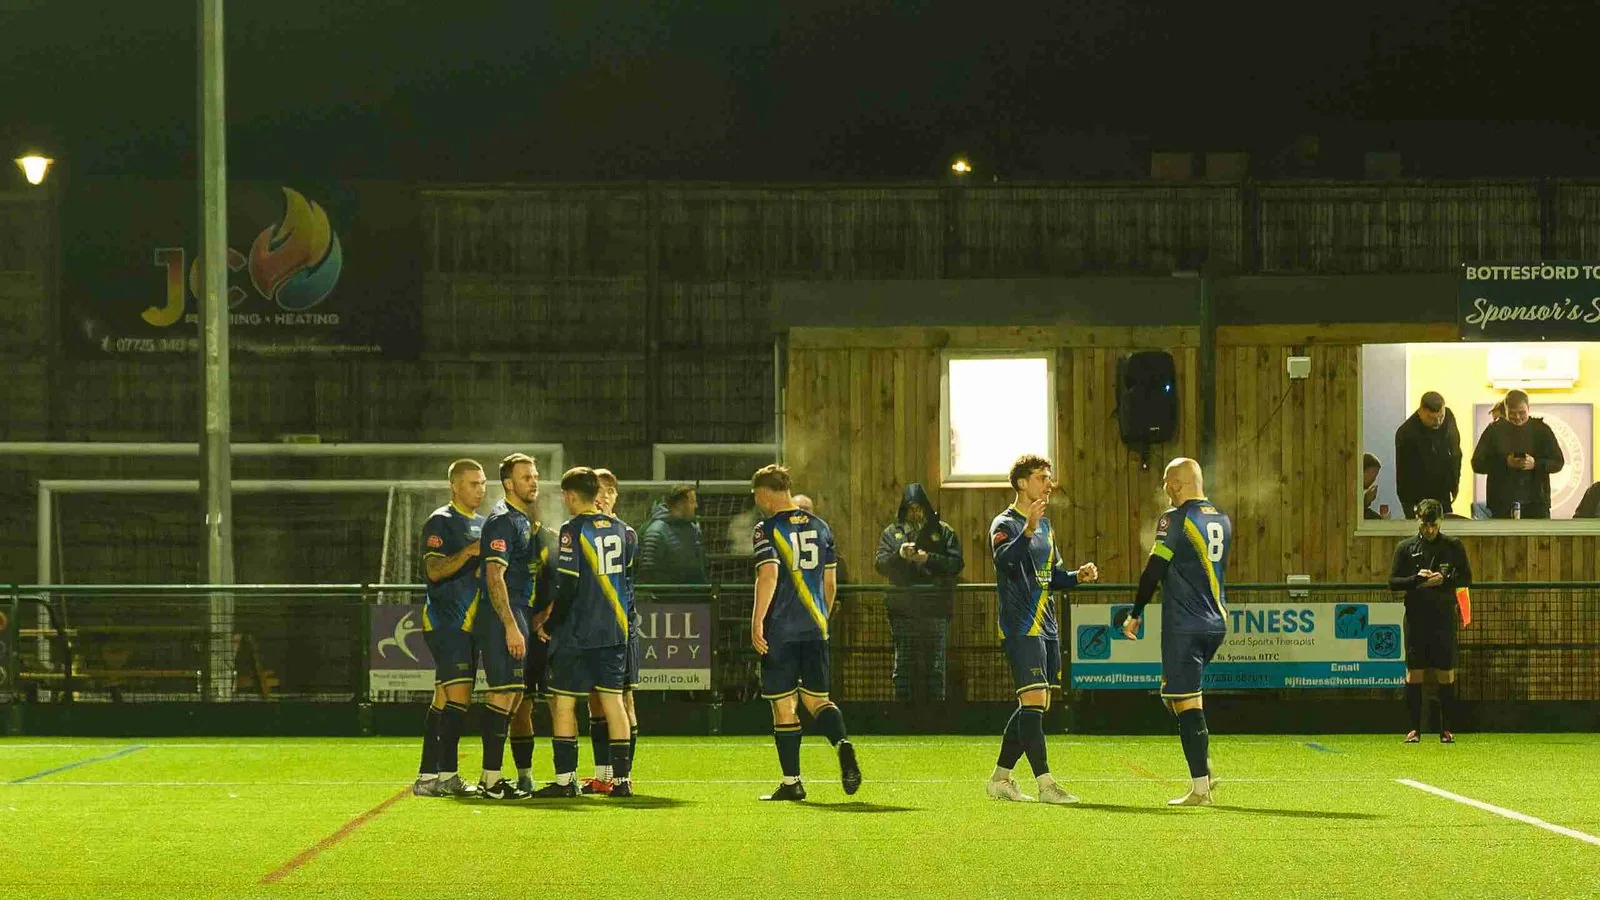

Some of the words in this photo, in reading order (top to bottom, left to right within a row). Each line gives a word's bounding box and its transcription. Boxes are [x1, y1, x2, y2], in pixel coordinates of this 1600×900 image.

[1466, 265, 1579, 281] BOTTESFORD
[275, 313, 340, 325] HEATING
[1465, 297, 1583, 330] Sponsor's
[788, 529, 819, 571] 15
[1206, 521, 1224, 562] 8
[593, 534, 623, 576] 12
[1229, 609, 1315, 634] TNESS
[1229, 638, 1245, 646] and
[1247, 637, 1274, 648] Sports
[1330, 662, 1360, 672] Email
[1074, 672, 1162, 685] www.njfitness.n
